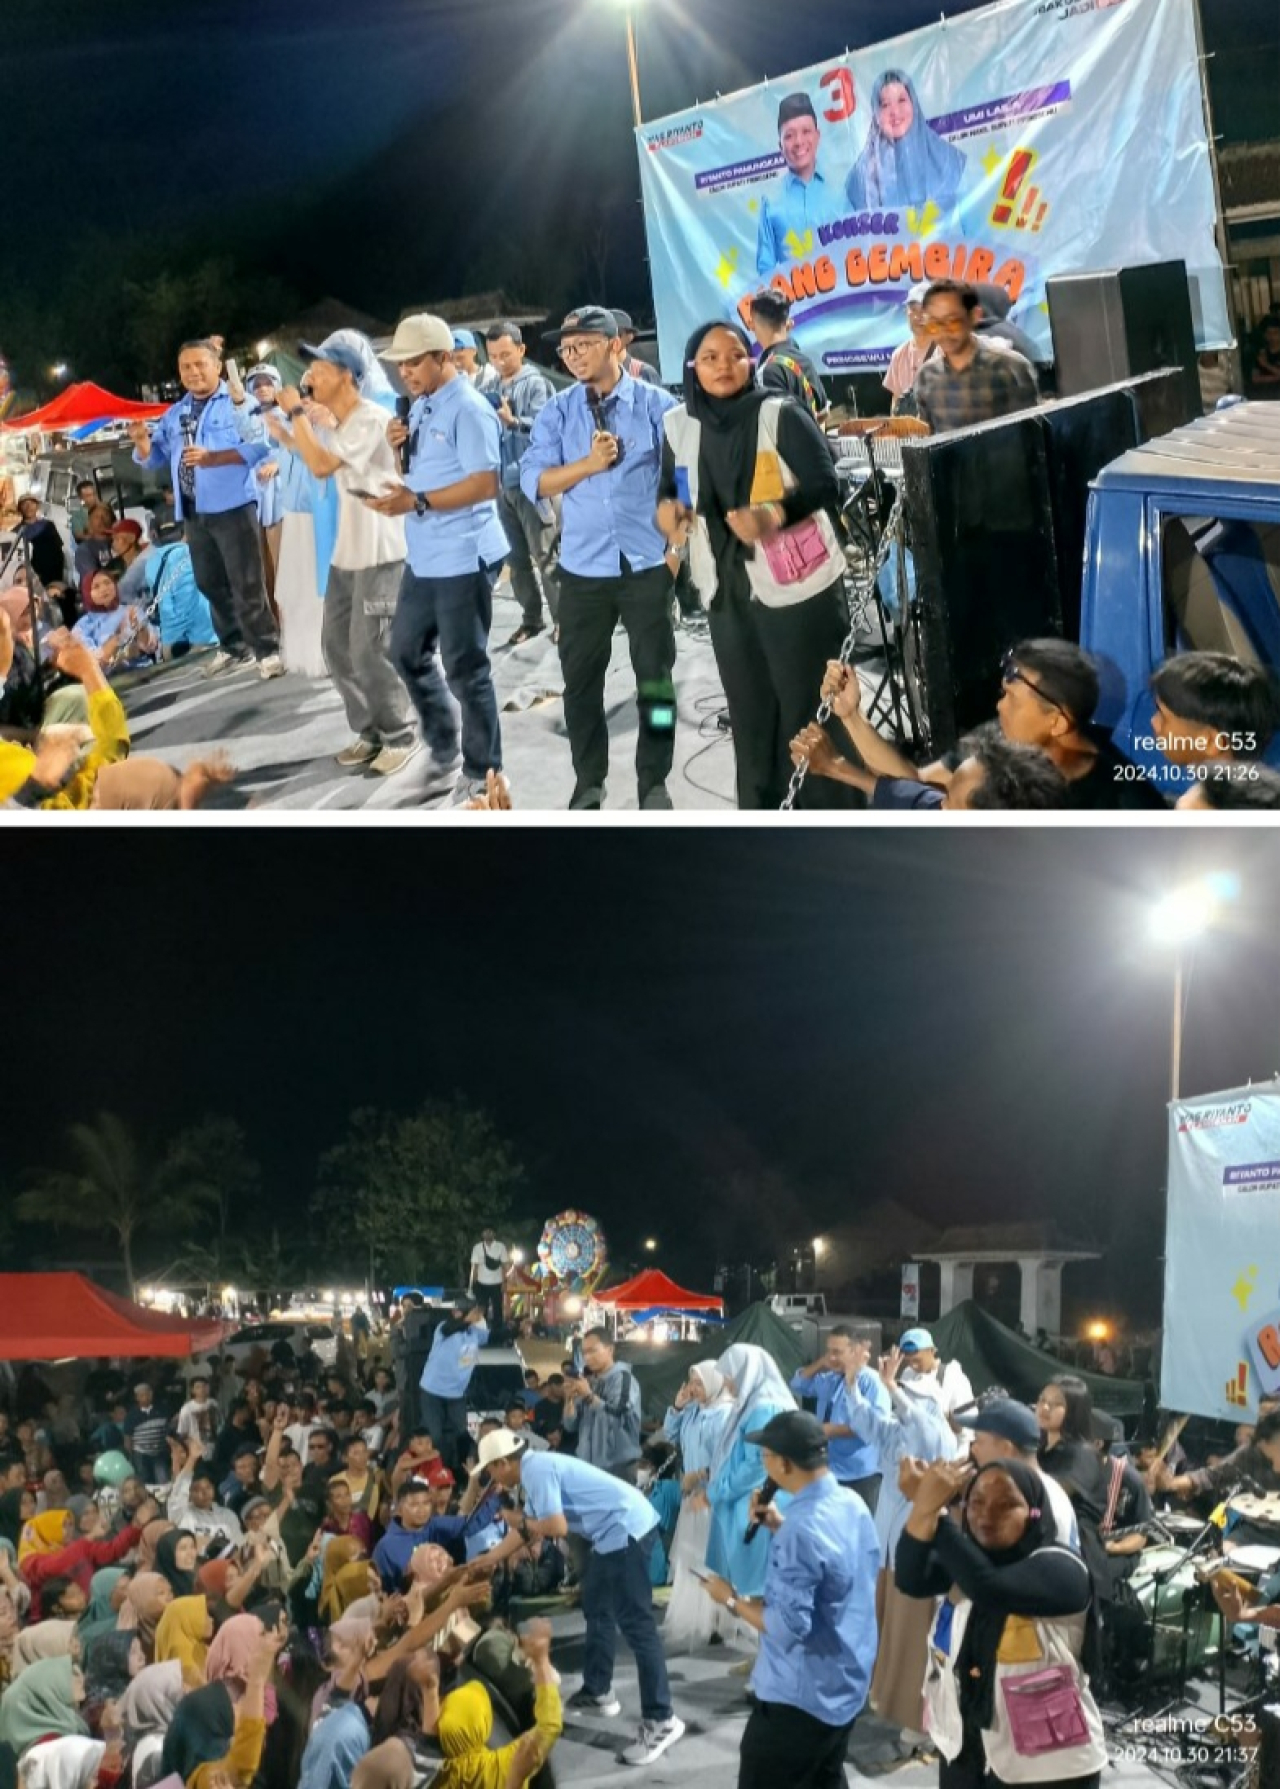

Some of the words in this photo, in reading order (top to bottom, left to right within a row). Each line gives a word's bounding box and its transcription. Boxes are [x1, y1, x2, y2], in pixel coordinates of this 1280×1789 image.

[820, 67, 857, 122] 3
[817, 212, 899, 246] KONSER
[845, 242, 1026, 304] GEMBIRA
